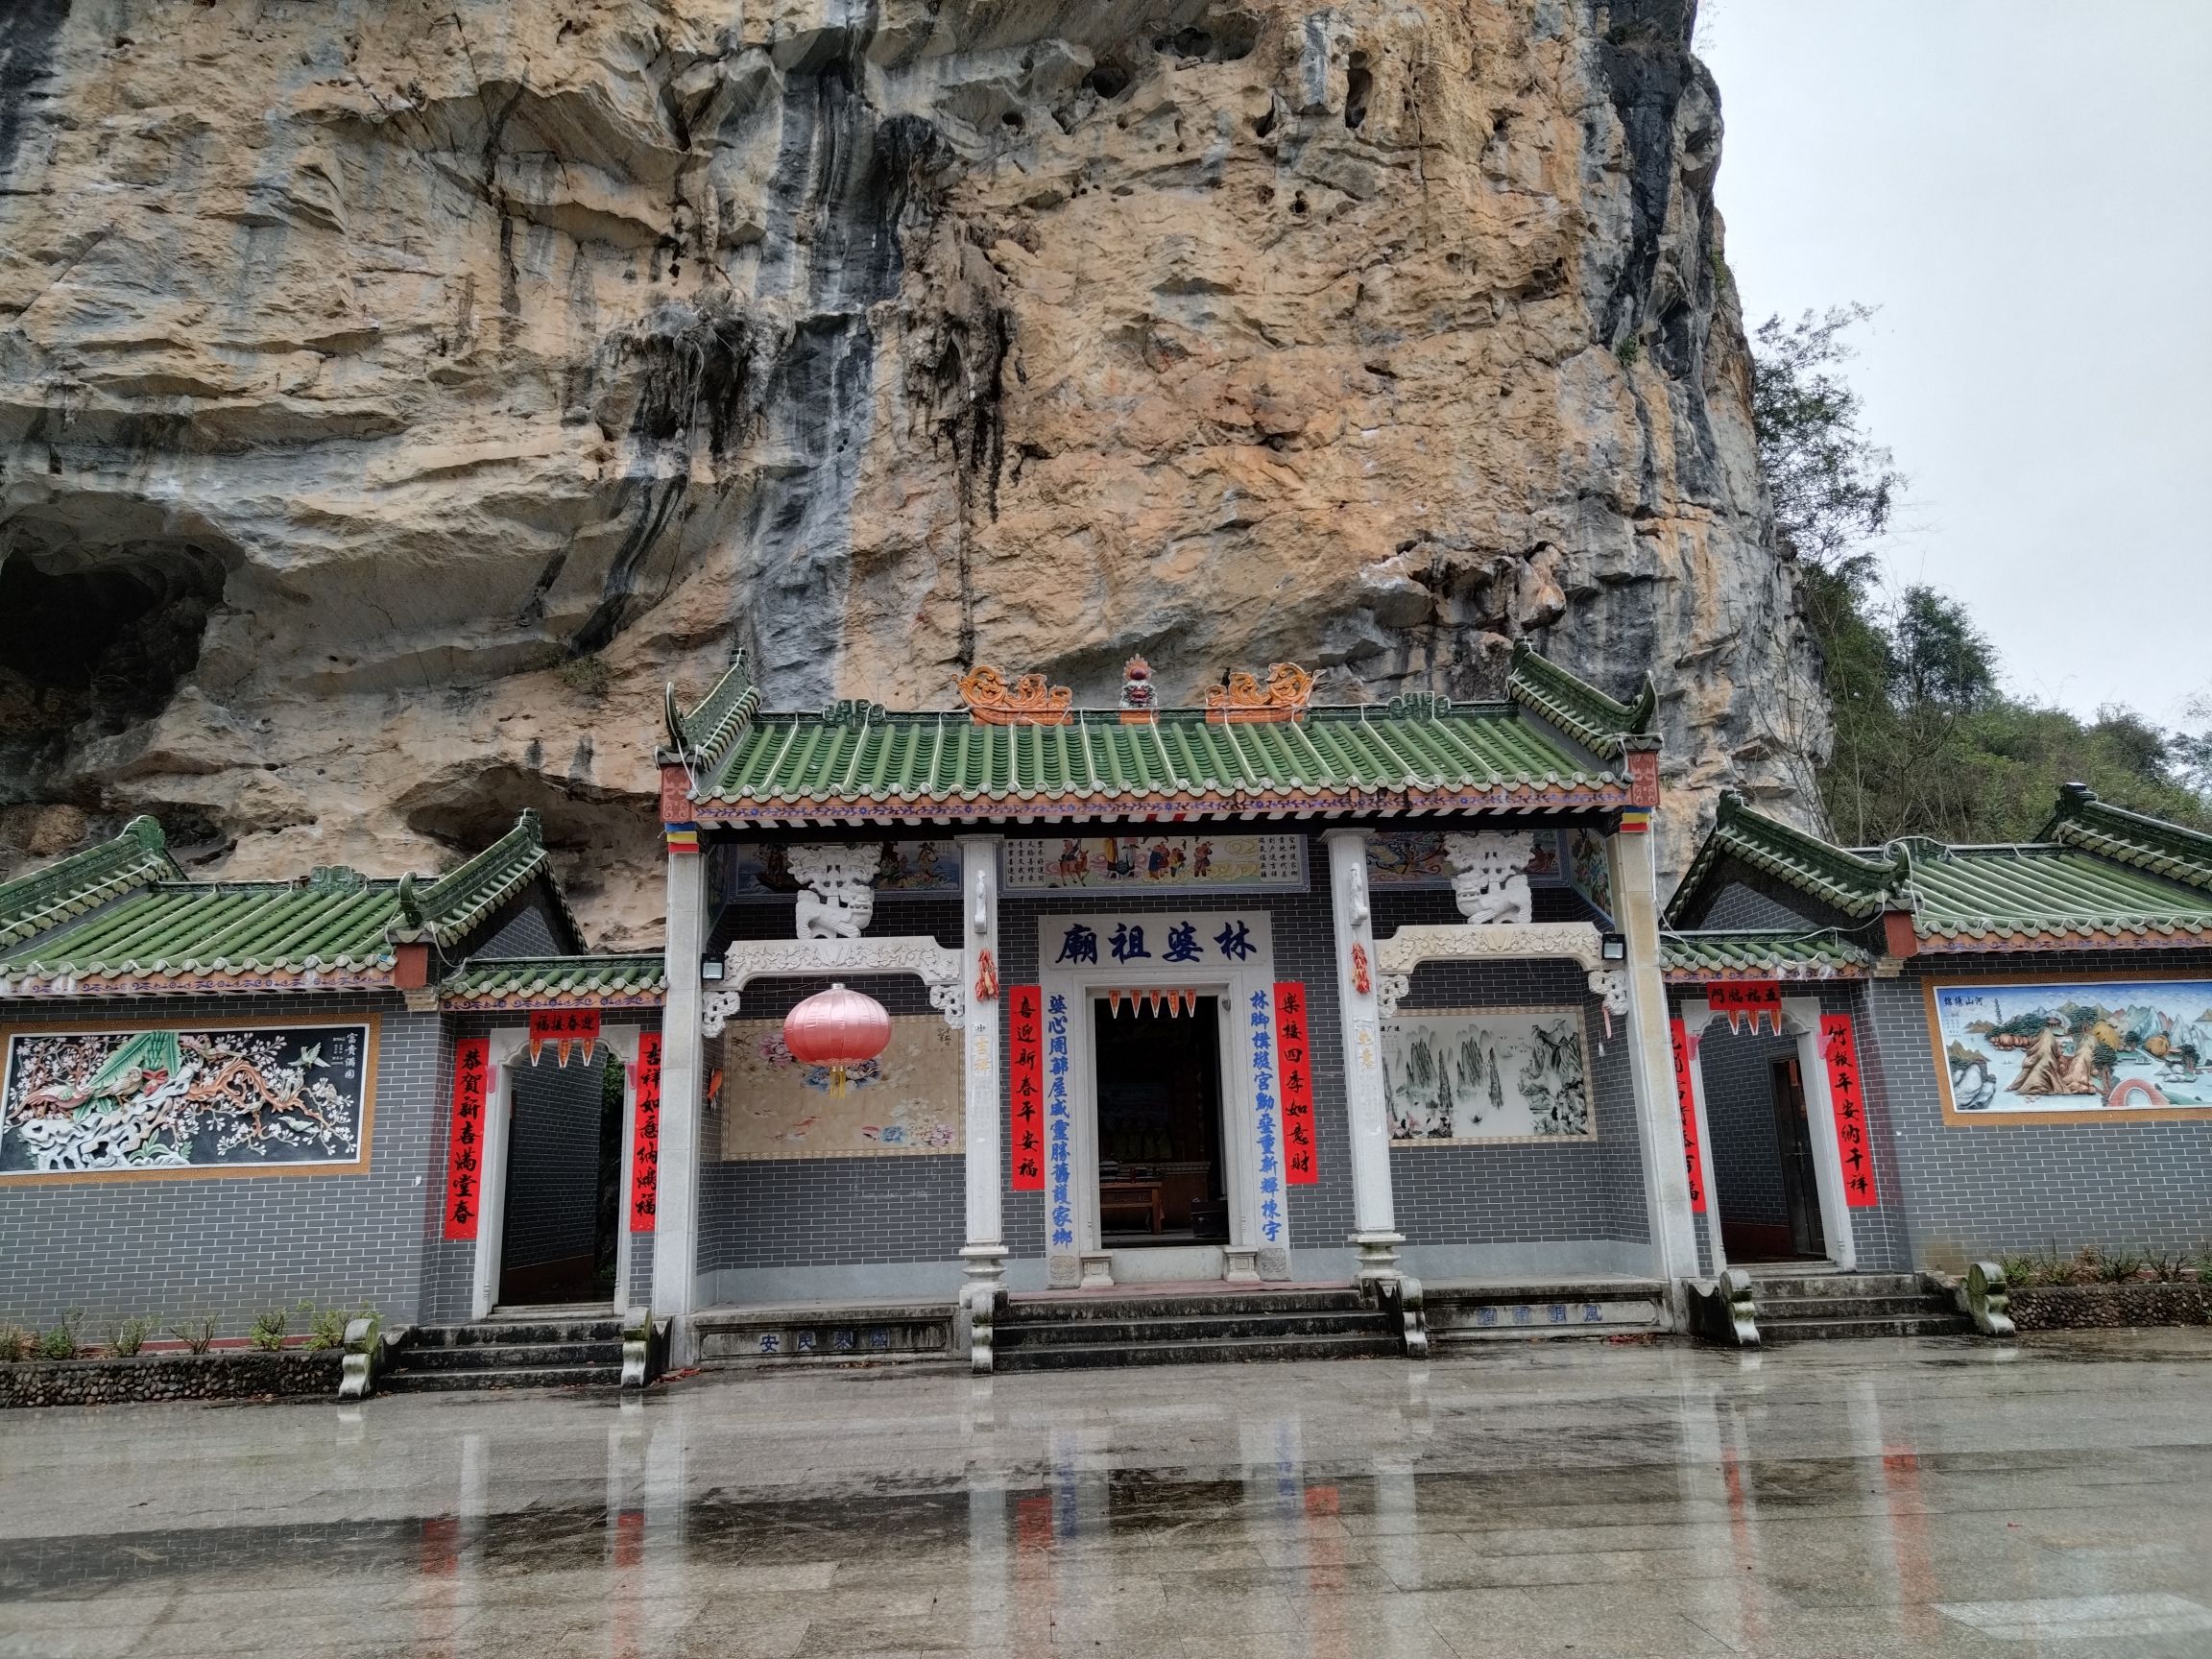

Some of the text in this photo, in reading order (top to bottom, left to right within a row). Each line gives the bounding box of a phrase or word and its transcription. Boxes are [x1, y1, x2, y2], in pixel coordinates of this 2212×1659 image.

[1014, 996, 1040, 1178] 喜迎新春平安福
[1828, 1023, 1869, 1197] 竹報平安納千祥
